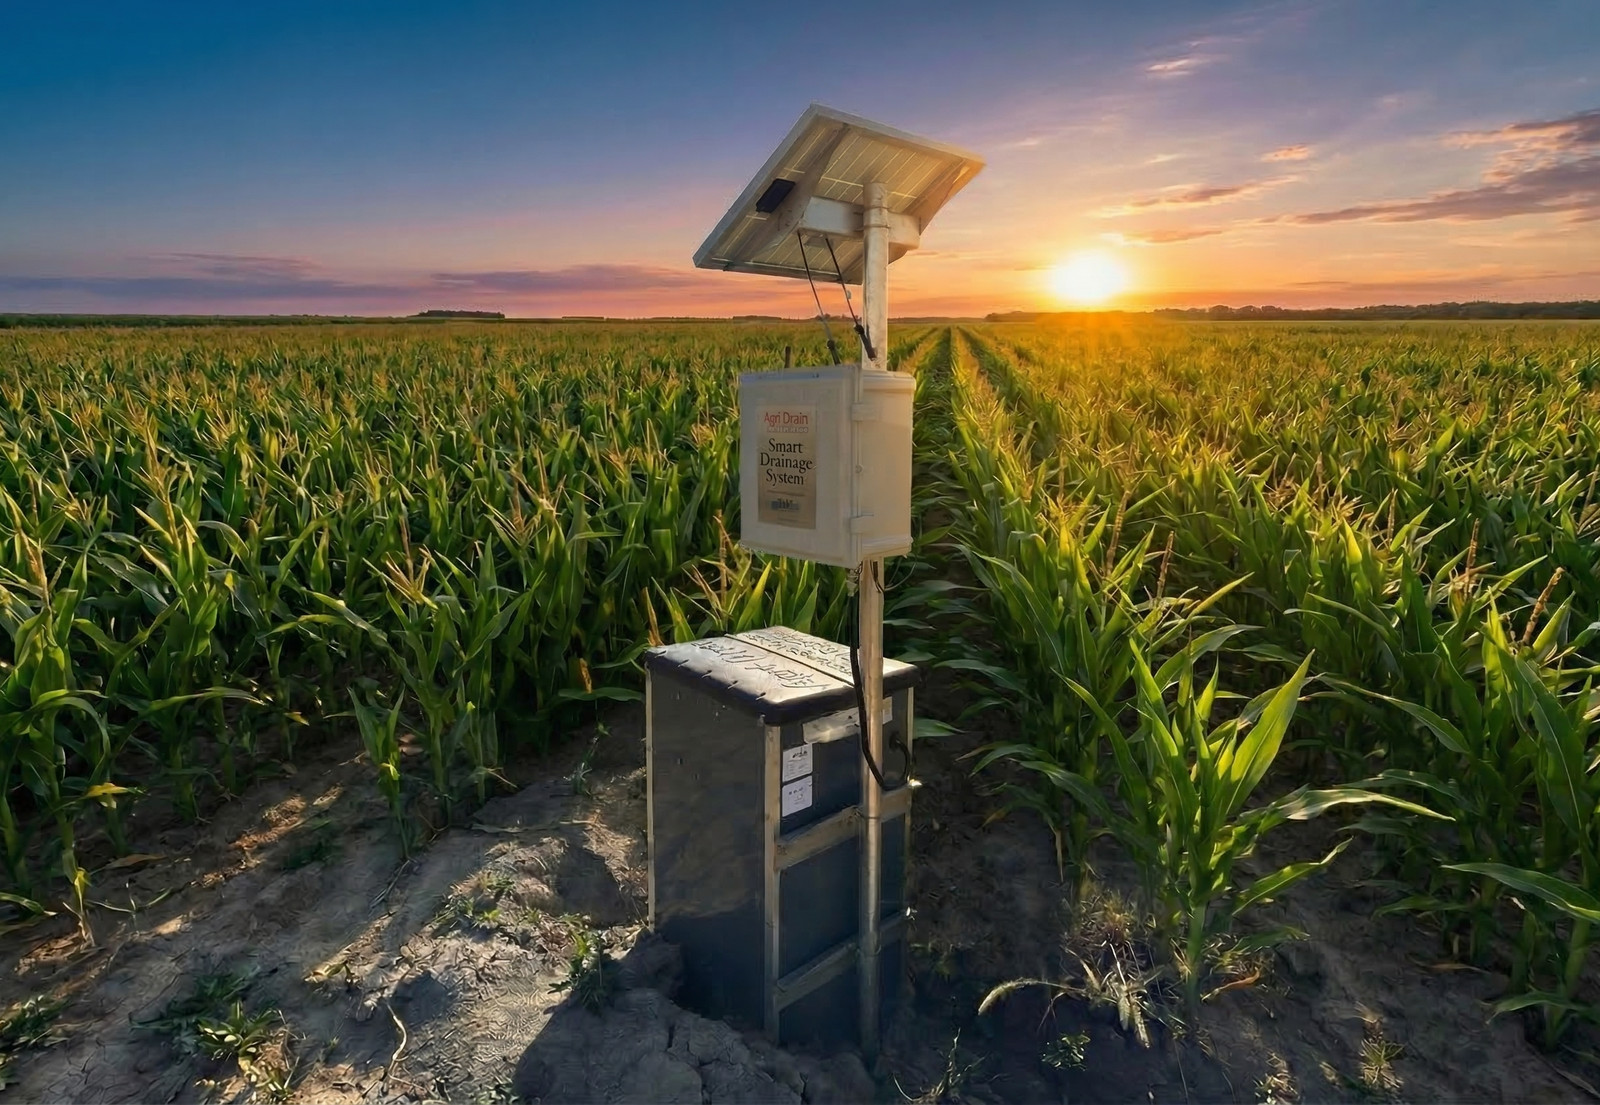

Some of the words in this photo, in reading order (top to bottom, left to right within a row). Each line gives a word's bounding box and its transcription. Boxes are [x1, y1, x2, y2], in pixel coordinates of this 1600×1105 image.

[764, 412, 780, 427] Agri
[783, 412, 808, 425] Drain
[769, 438, 803, 453] Smart
[760, 453, 813, 473] Drainage
[766, 469, 804, 486] System
